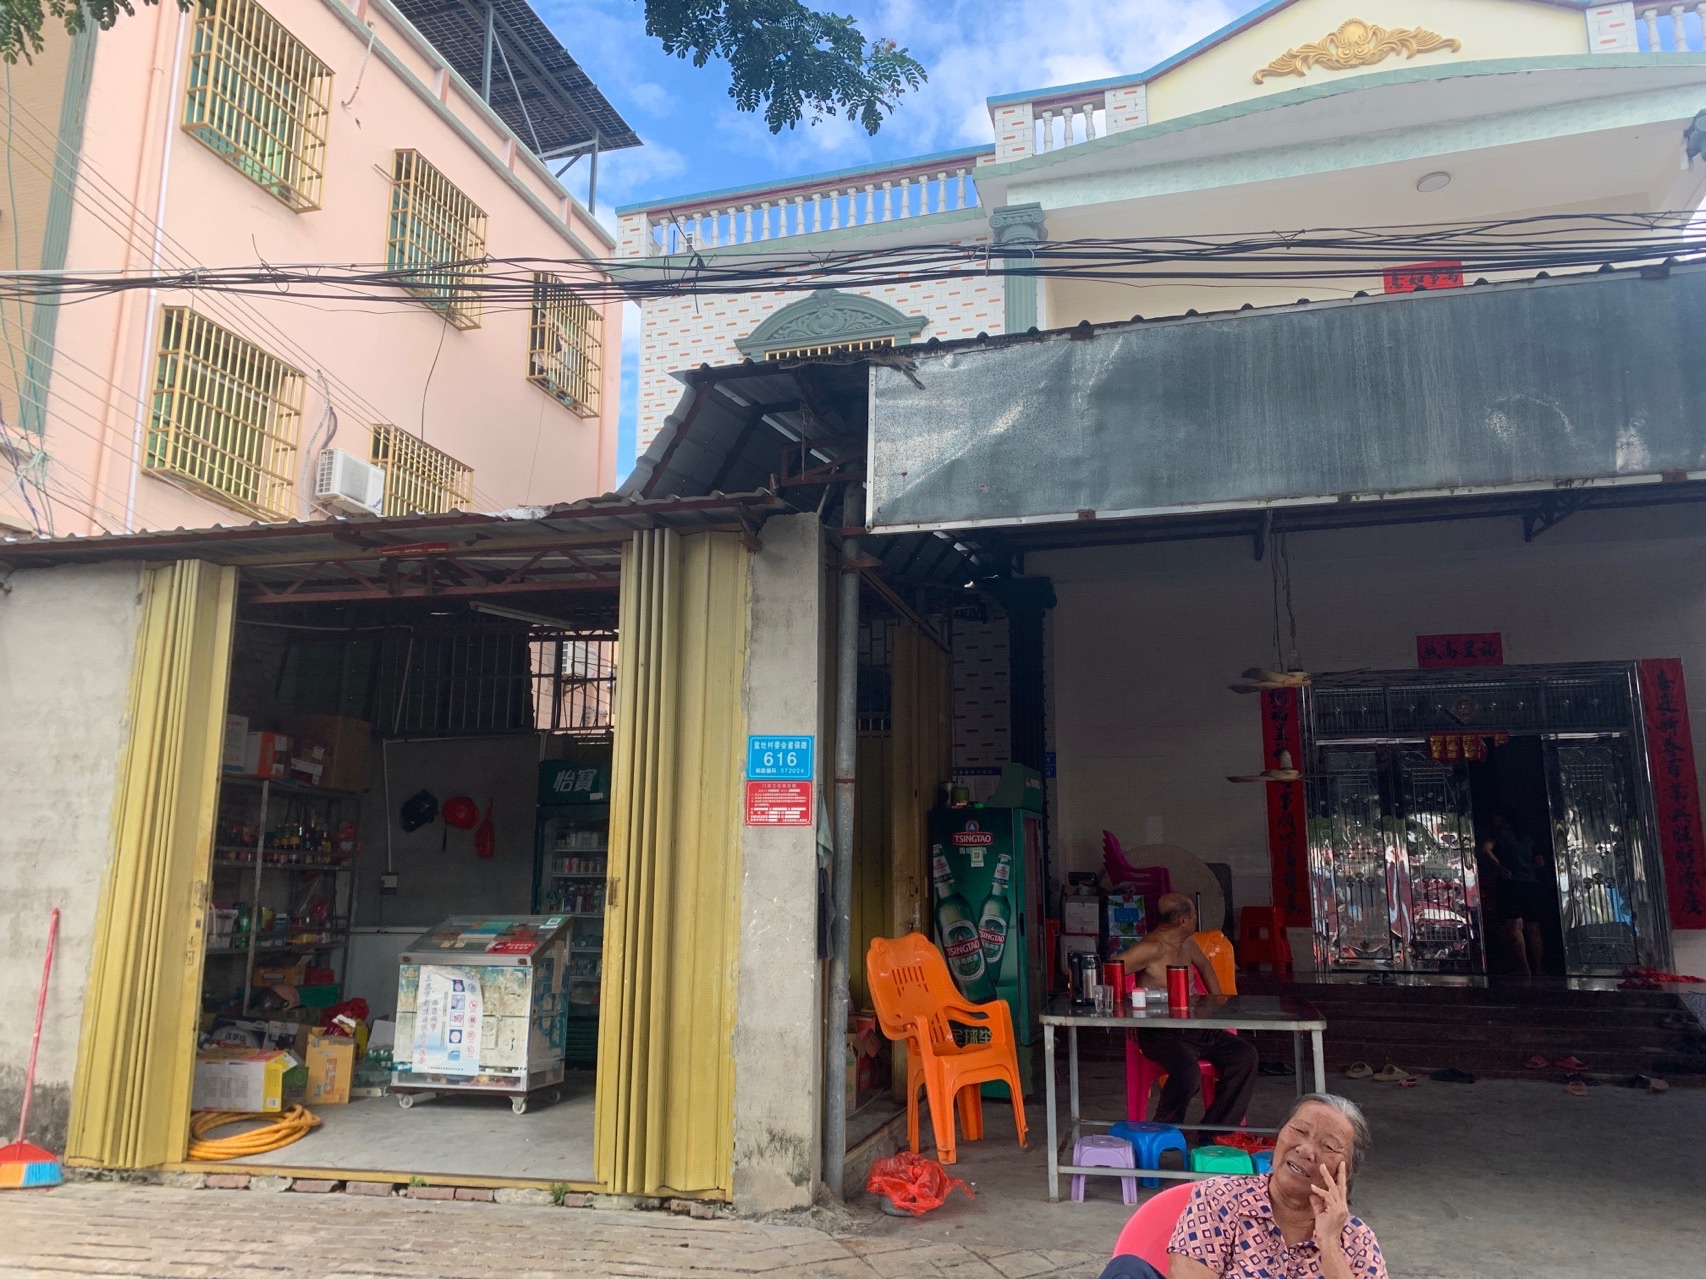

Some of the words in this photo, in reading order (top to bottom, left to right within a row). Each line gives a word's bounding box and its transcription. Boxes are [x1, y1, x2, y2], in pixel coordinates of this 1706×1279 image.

[763, 751, 797, 767] 616
[552, 768, 598, 792] 怡寶
[954, 834, 992, 843] TSINGTAO
[945, 940, 980, 956] TSINGTAO
